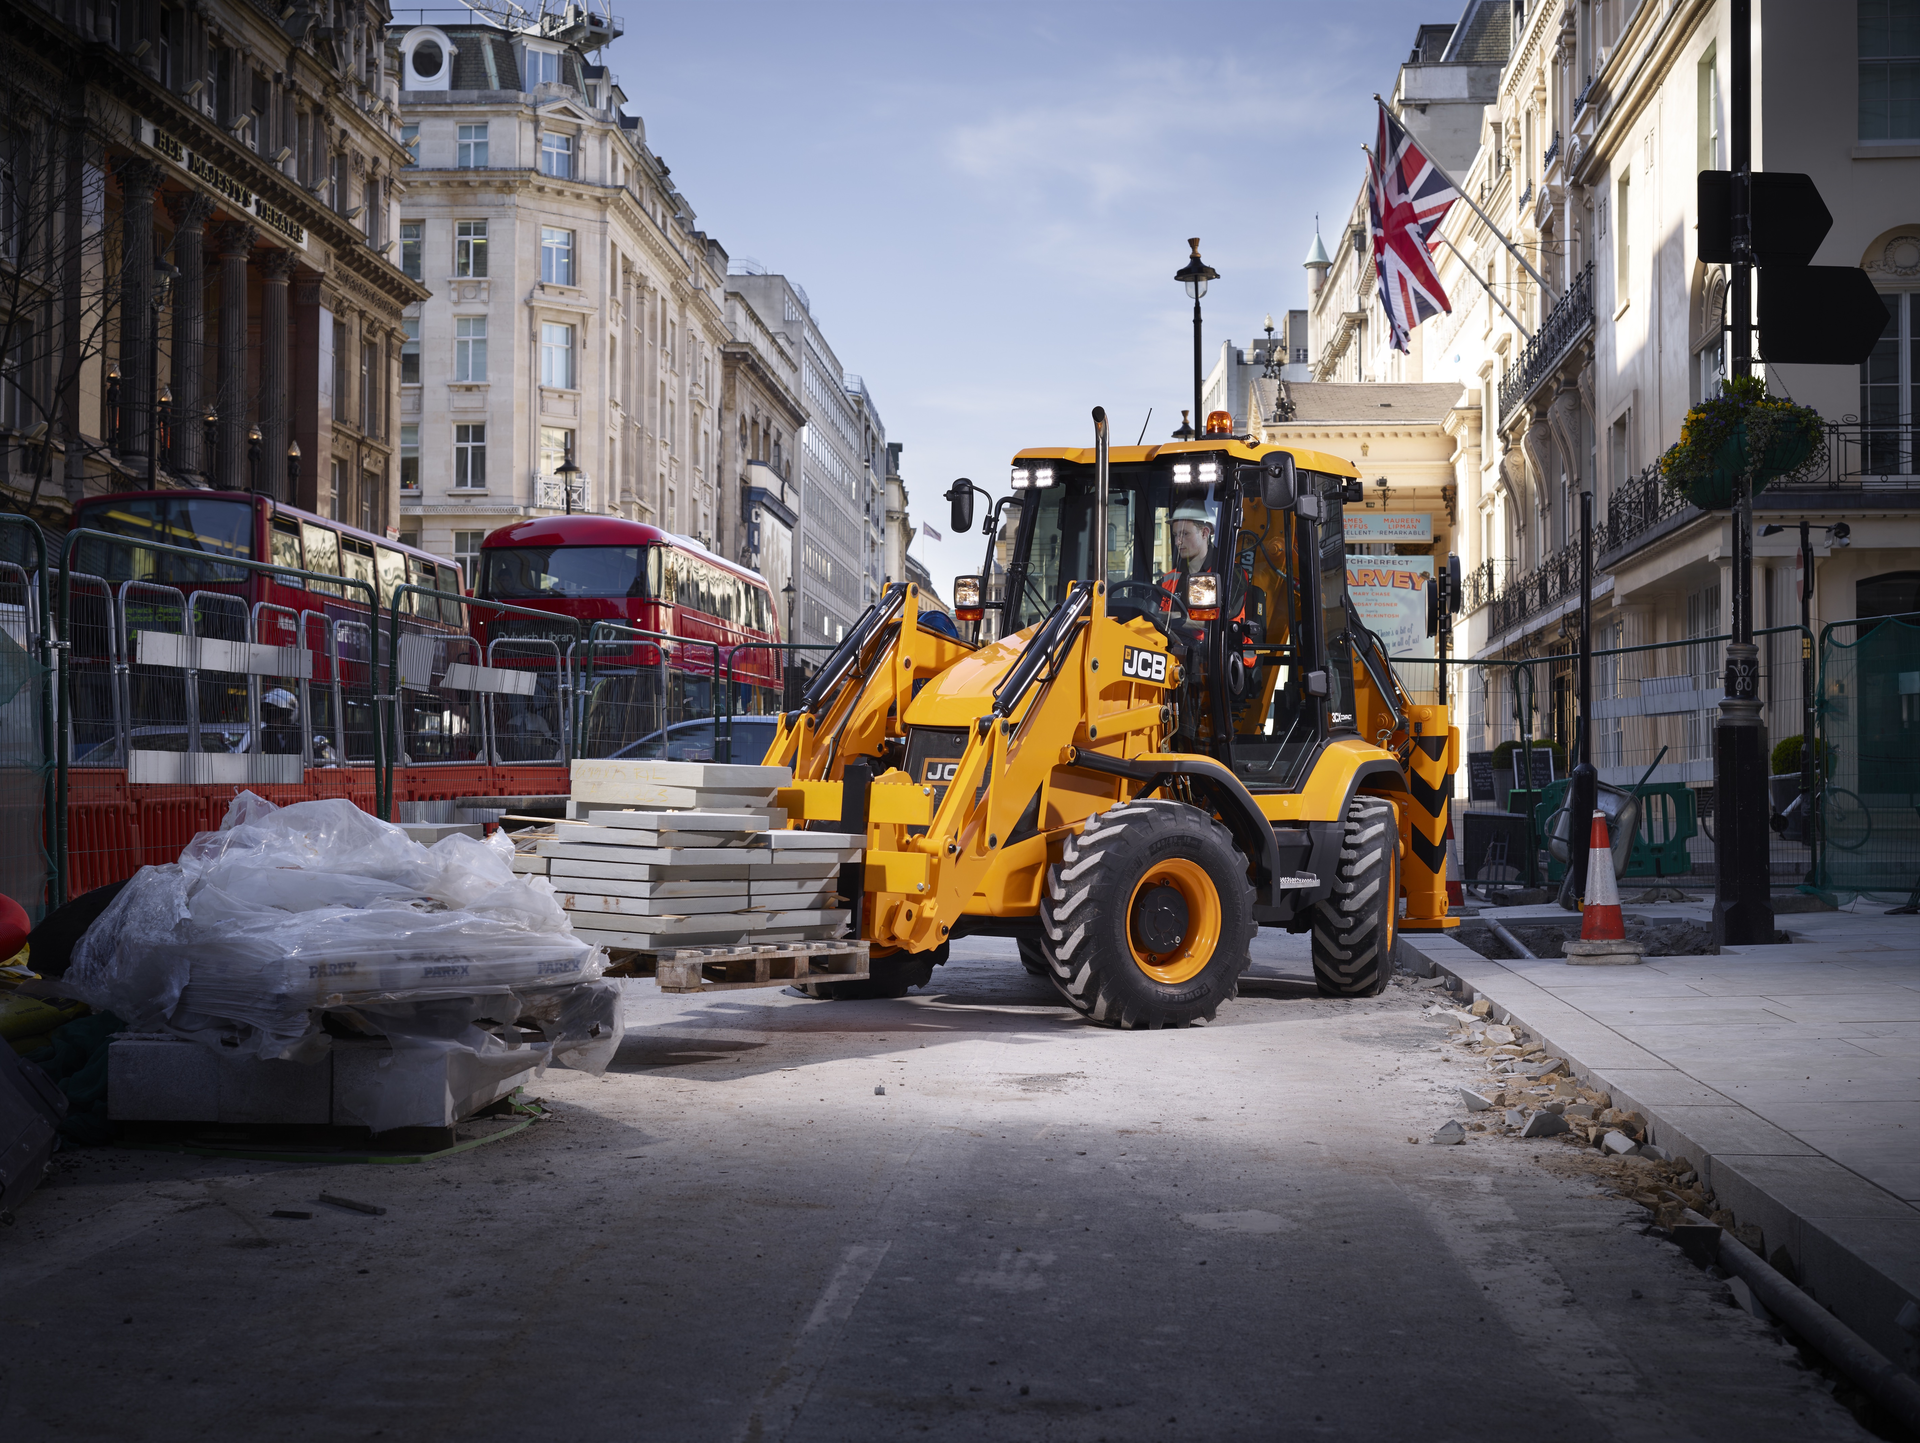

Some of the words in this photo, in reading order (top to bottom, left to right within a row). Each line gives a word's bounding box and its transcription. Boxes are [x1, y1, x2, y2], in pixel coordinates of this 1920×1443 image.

[155, 129, 184, 162] HER
[189, 153, 252, 207] MAJESTY'S
[256, 199, 304, 243] THEATRE
[1347, 569, 1425, 591] ARVEY
[542, 632, 576, 643] Library
[599, 628, 617, 648] 12
[1124, 649, 1166, 681] JCB
[927, 763, 960, 780] JC
[308, 961, 358, 979] PAREX
[423, 965, 470, 977] PAREX
[537, 959, 581, 974] PAREX
